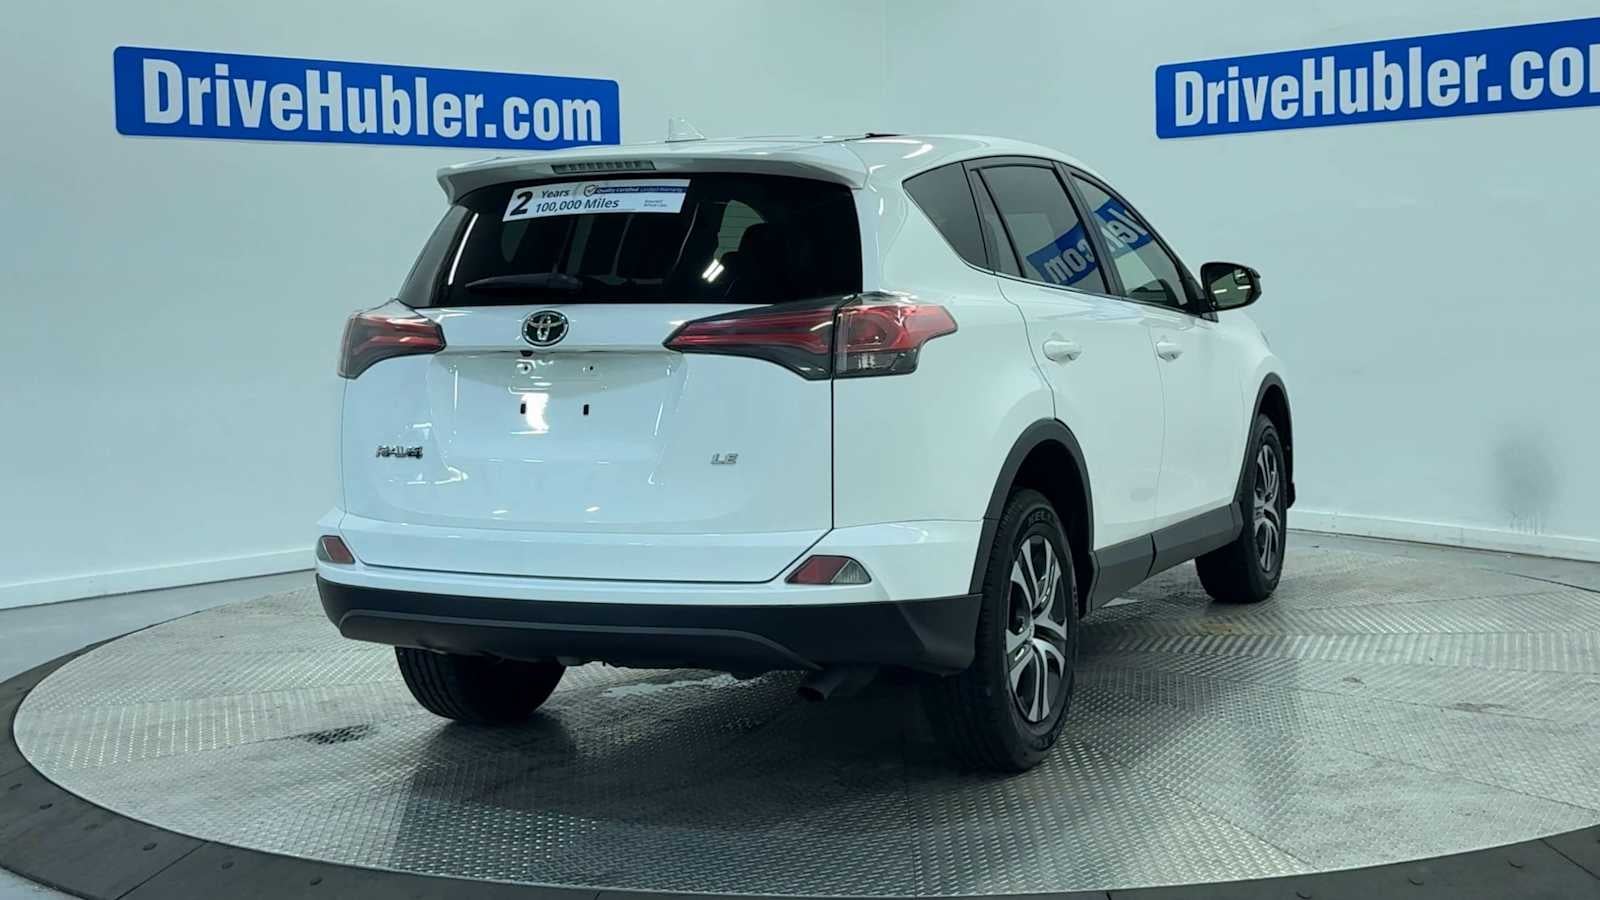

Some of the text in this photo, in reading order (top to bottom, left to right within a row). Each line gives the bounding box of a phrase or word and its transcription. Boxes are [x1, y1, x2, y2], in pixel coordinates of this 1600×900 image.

[1174, 43, 1600, 128] DriveHubler.co
[142, 58, 602, 142] DriveHubler.com
[510, 191, 533, 216] 2
[541, 189, 571, 198] Years
[536, 200, 581, 213] 100,000
[584, 198, 620, 209] Miles
[710, 453, 739, 465] LE
